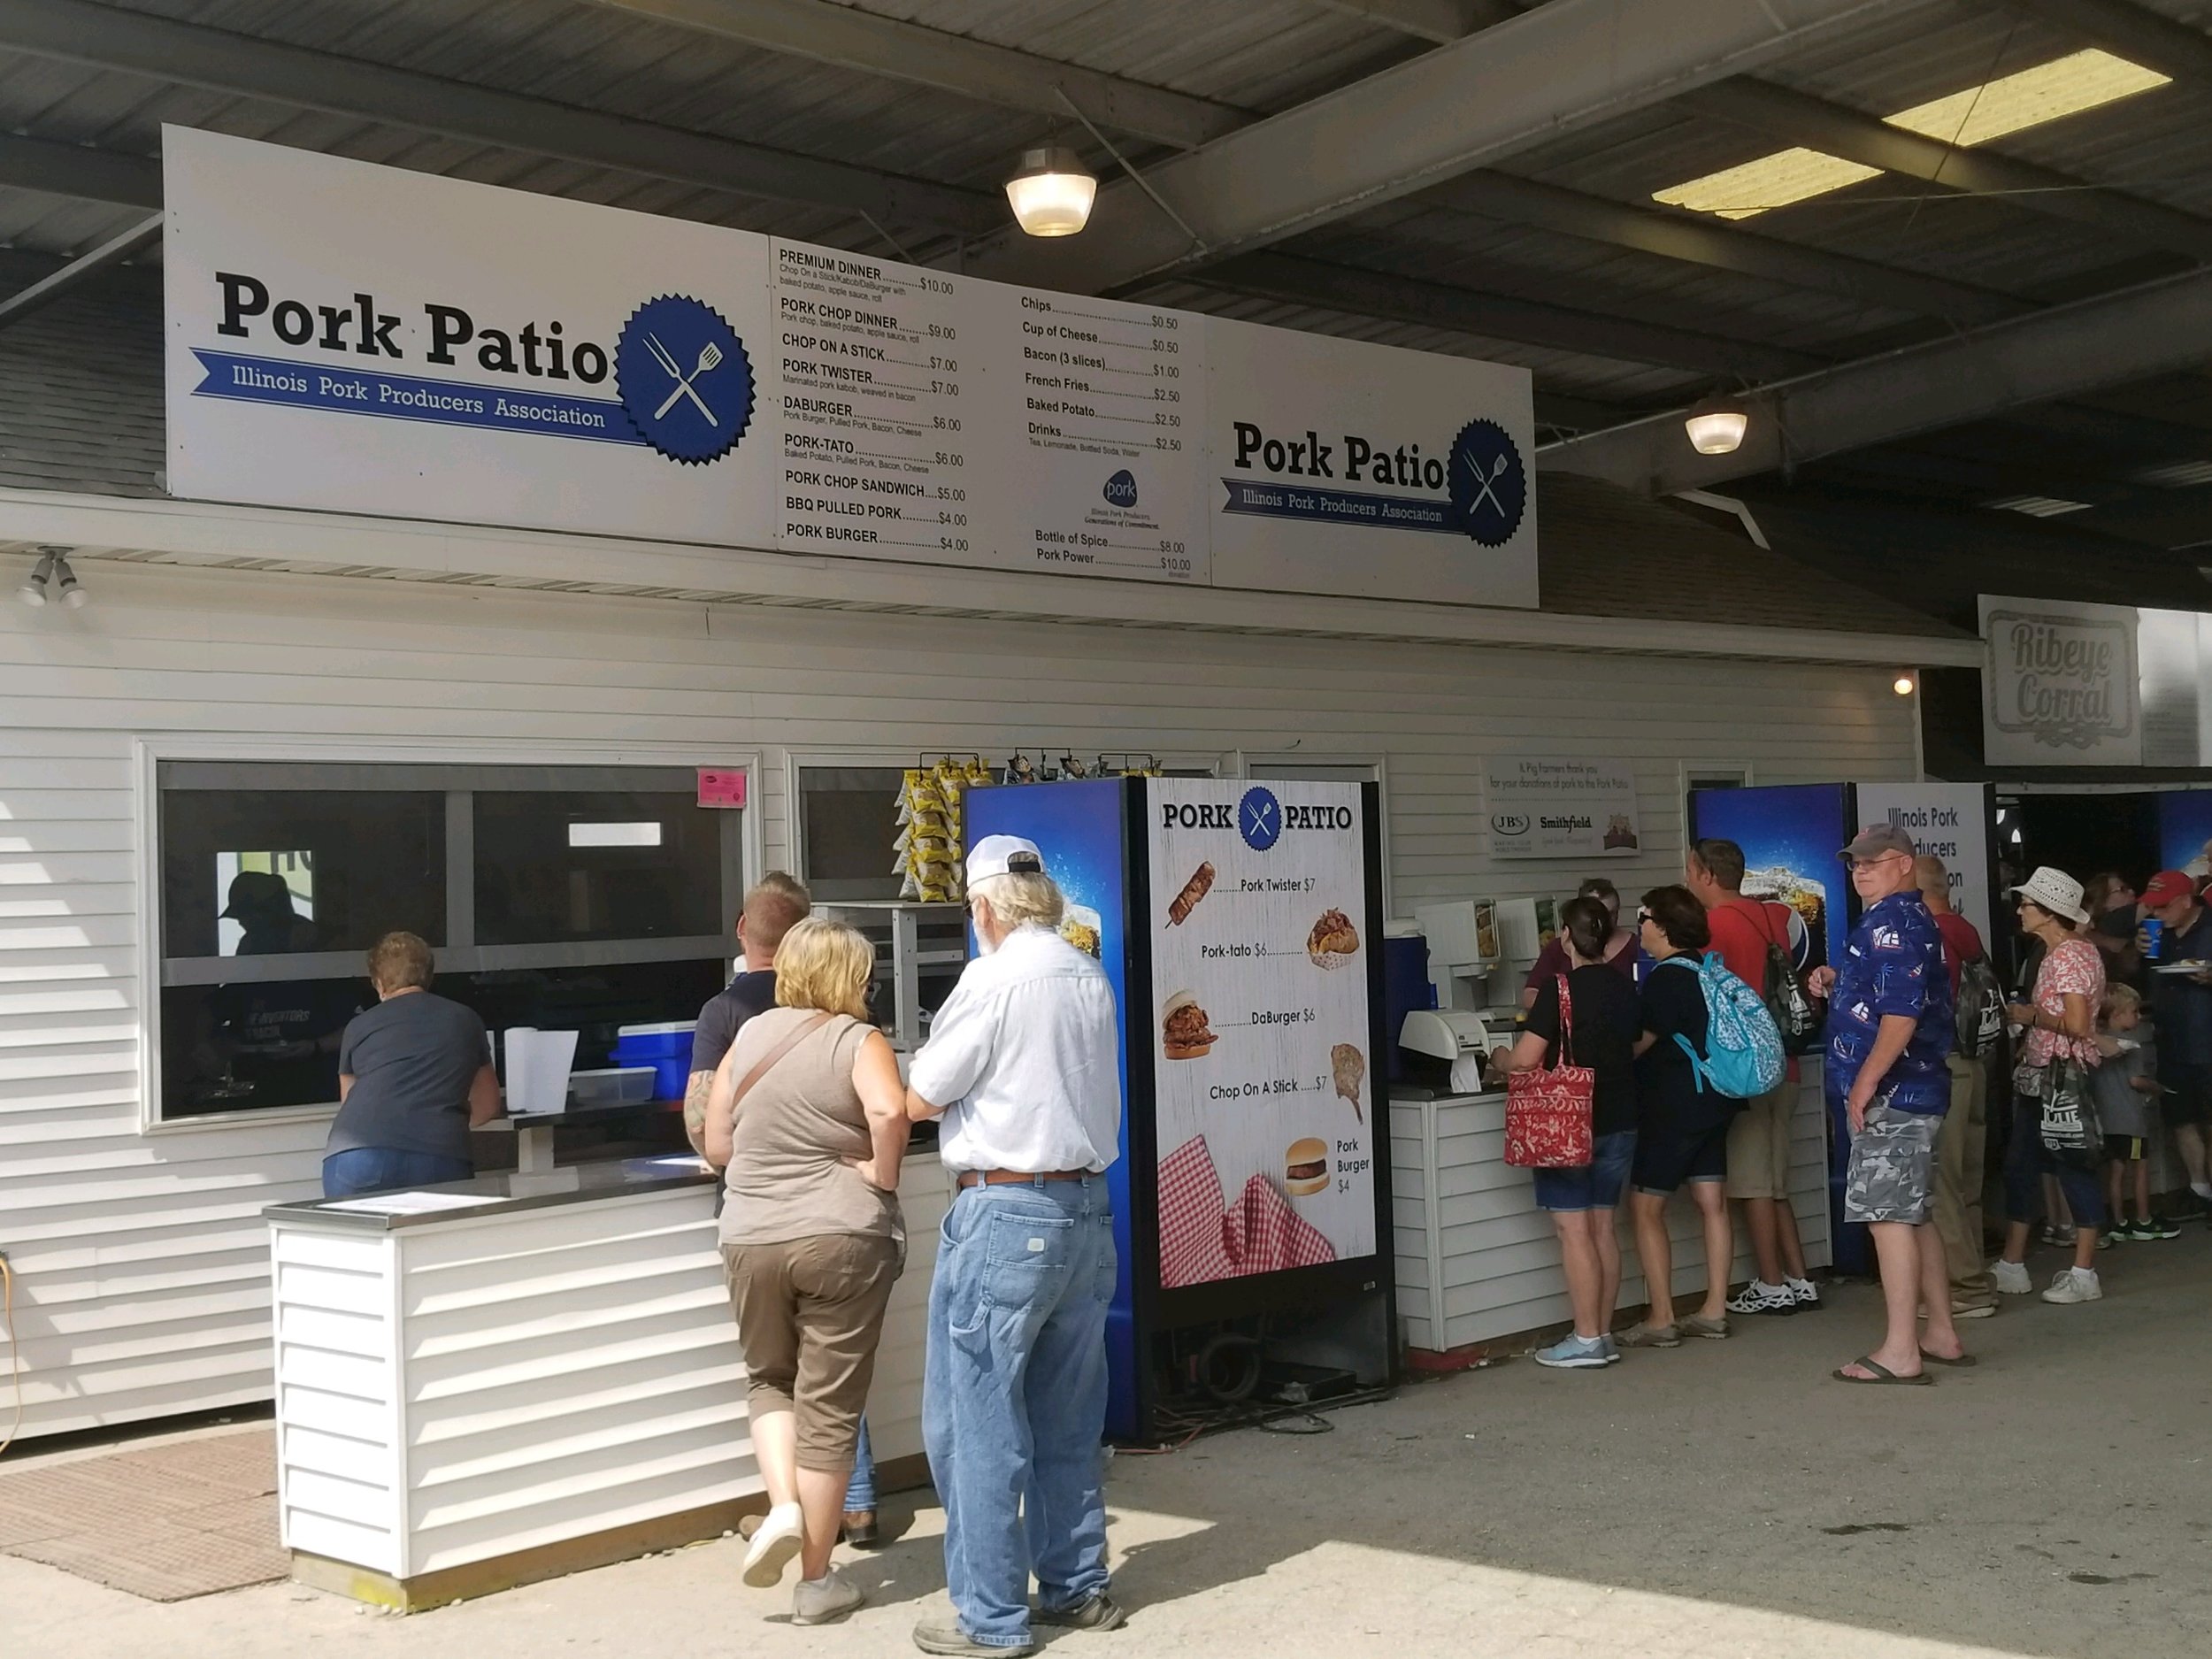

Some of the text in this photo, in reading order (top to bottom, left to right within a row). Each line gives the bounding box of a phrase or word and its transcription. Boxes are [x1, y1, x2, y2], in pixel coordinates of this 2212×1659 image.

[780, 249, 953, 295] PREMIUM DINNER $10.00
[780, 265, 799, 275] Chop
[893, 287, 906, 296] with
[781, 297, 956, 340] PORK CHOP DINNER $9.00
[1021, 296, 1178, 329] Chips $0.50
[215, 272, 608, 385] Pork Patio
[1023, 322, 1179, 353] Cup of Cheese $0.50
[782, 334, 957, 372] CHOP ON A STICK $7.00
[1024, 347, 1179, 379] Bacon (3 slices) $1.00
[783, 358, 958, 396] PORK TWISTER $7.00
[819, 380, 834, 390] pork
[861, 386, 887, 397] weaved
[895, 392, 916, 402] bacon
[1025, 373, 1180, 403] French Fries $2.50
[232, 365, 605, 428] Illinois Pork Producers Association
[784, 396, 961, 431] DABURGER $6.00
[1027, 397, 1180, 427] Baked Potato $2.50
[785, 434, 963, 466] PORK-TATO $6.00
[1028, 423, 1181, 451] Drinks $2.50
[1233, 421, 1444, 489] Pork Patio
[786, 470, 965, 501] PORK CHOP SANDWICH $5.00
[1107, 480, 1135, 500] pork
[786, 496, 966, 526] BBQ PULLED PORK $4.00
[1242, 489, 1442, 523] Illinois Pork Producers Association
[787, 524, 968, 551] PORK BURGER $4.00
[1035, 530, 1185, 553] Bottle of Spice $8.00
[1037, 549, 1191, 571] Pork Power $10.00
[2011, 623, 2112, 685] Ribeye
[2017, 674, 2111, 720] Corral
[1164, 804, 1352, 829] PORK PATIO
[1498, 815, 1592, 833] JBS Smithfield
[1888, 808, 1958, 827] Illinois Pork
[1915, 839, 1956, 856] ducers
[1240, 879, 1315, 894] Pork Twister $7
[1202, 943, 1266, 958] Pork-tato $6
[1252, 1009, 1315, 1025] DaBurger $6
[1210, 1076, 1327, 1101] Chop On A Stick $7
[1337, 1139, 1358, 1153] Pork
[1337, 1158, 1370, 1173] Burger
[1338, 1179, 1349, 1194] $4
